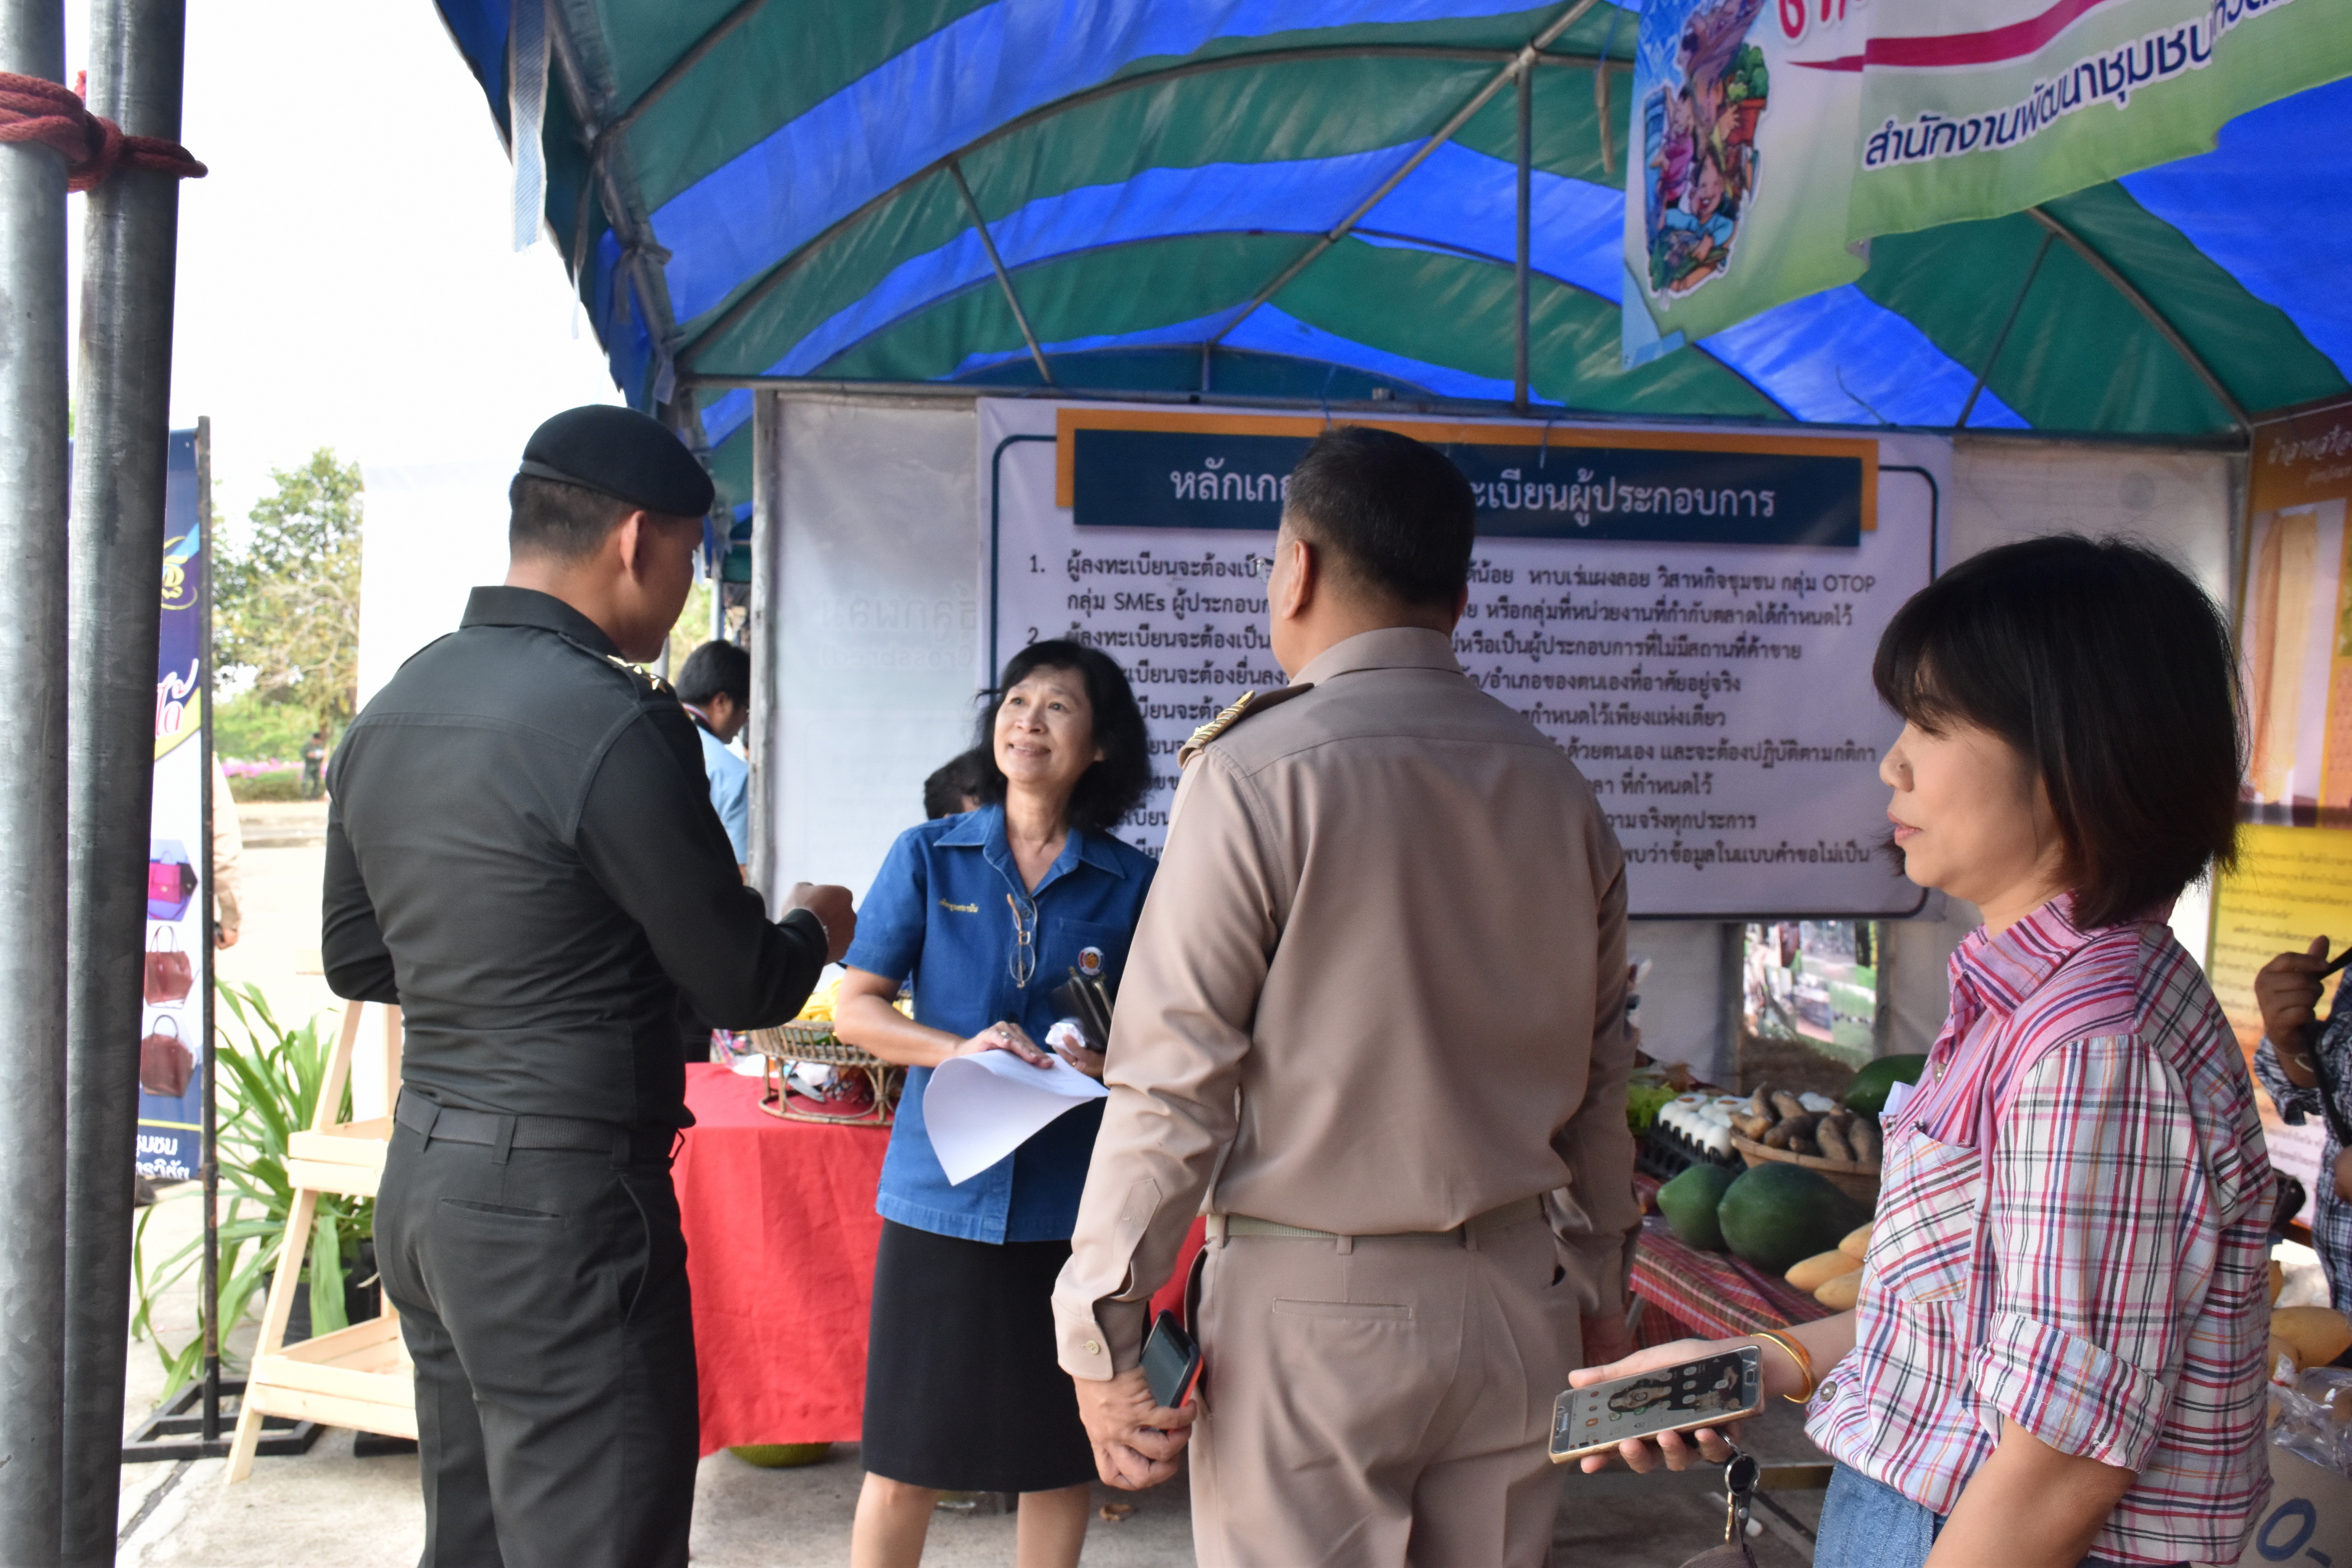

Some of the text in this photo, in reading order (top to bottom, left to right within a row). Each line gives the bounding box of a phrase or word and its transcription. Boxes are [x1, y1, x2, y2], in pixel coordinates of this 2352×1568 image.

[1028, 553, 1046, 574] 1.
[1658, 564, 1776, 598] วิสาหกิจชุมชน
[1781, 570, 1817, 599] กลุ่ม
[1823, 575, 1877, 594] OTOP
[1067, 588, 1106, 619] กลุ่ม
[1113, 592, 1166, 613] SMEs
